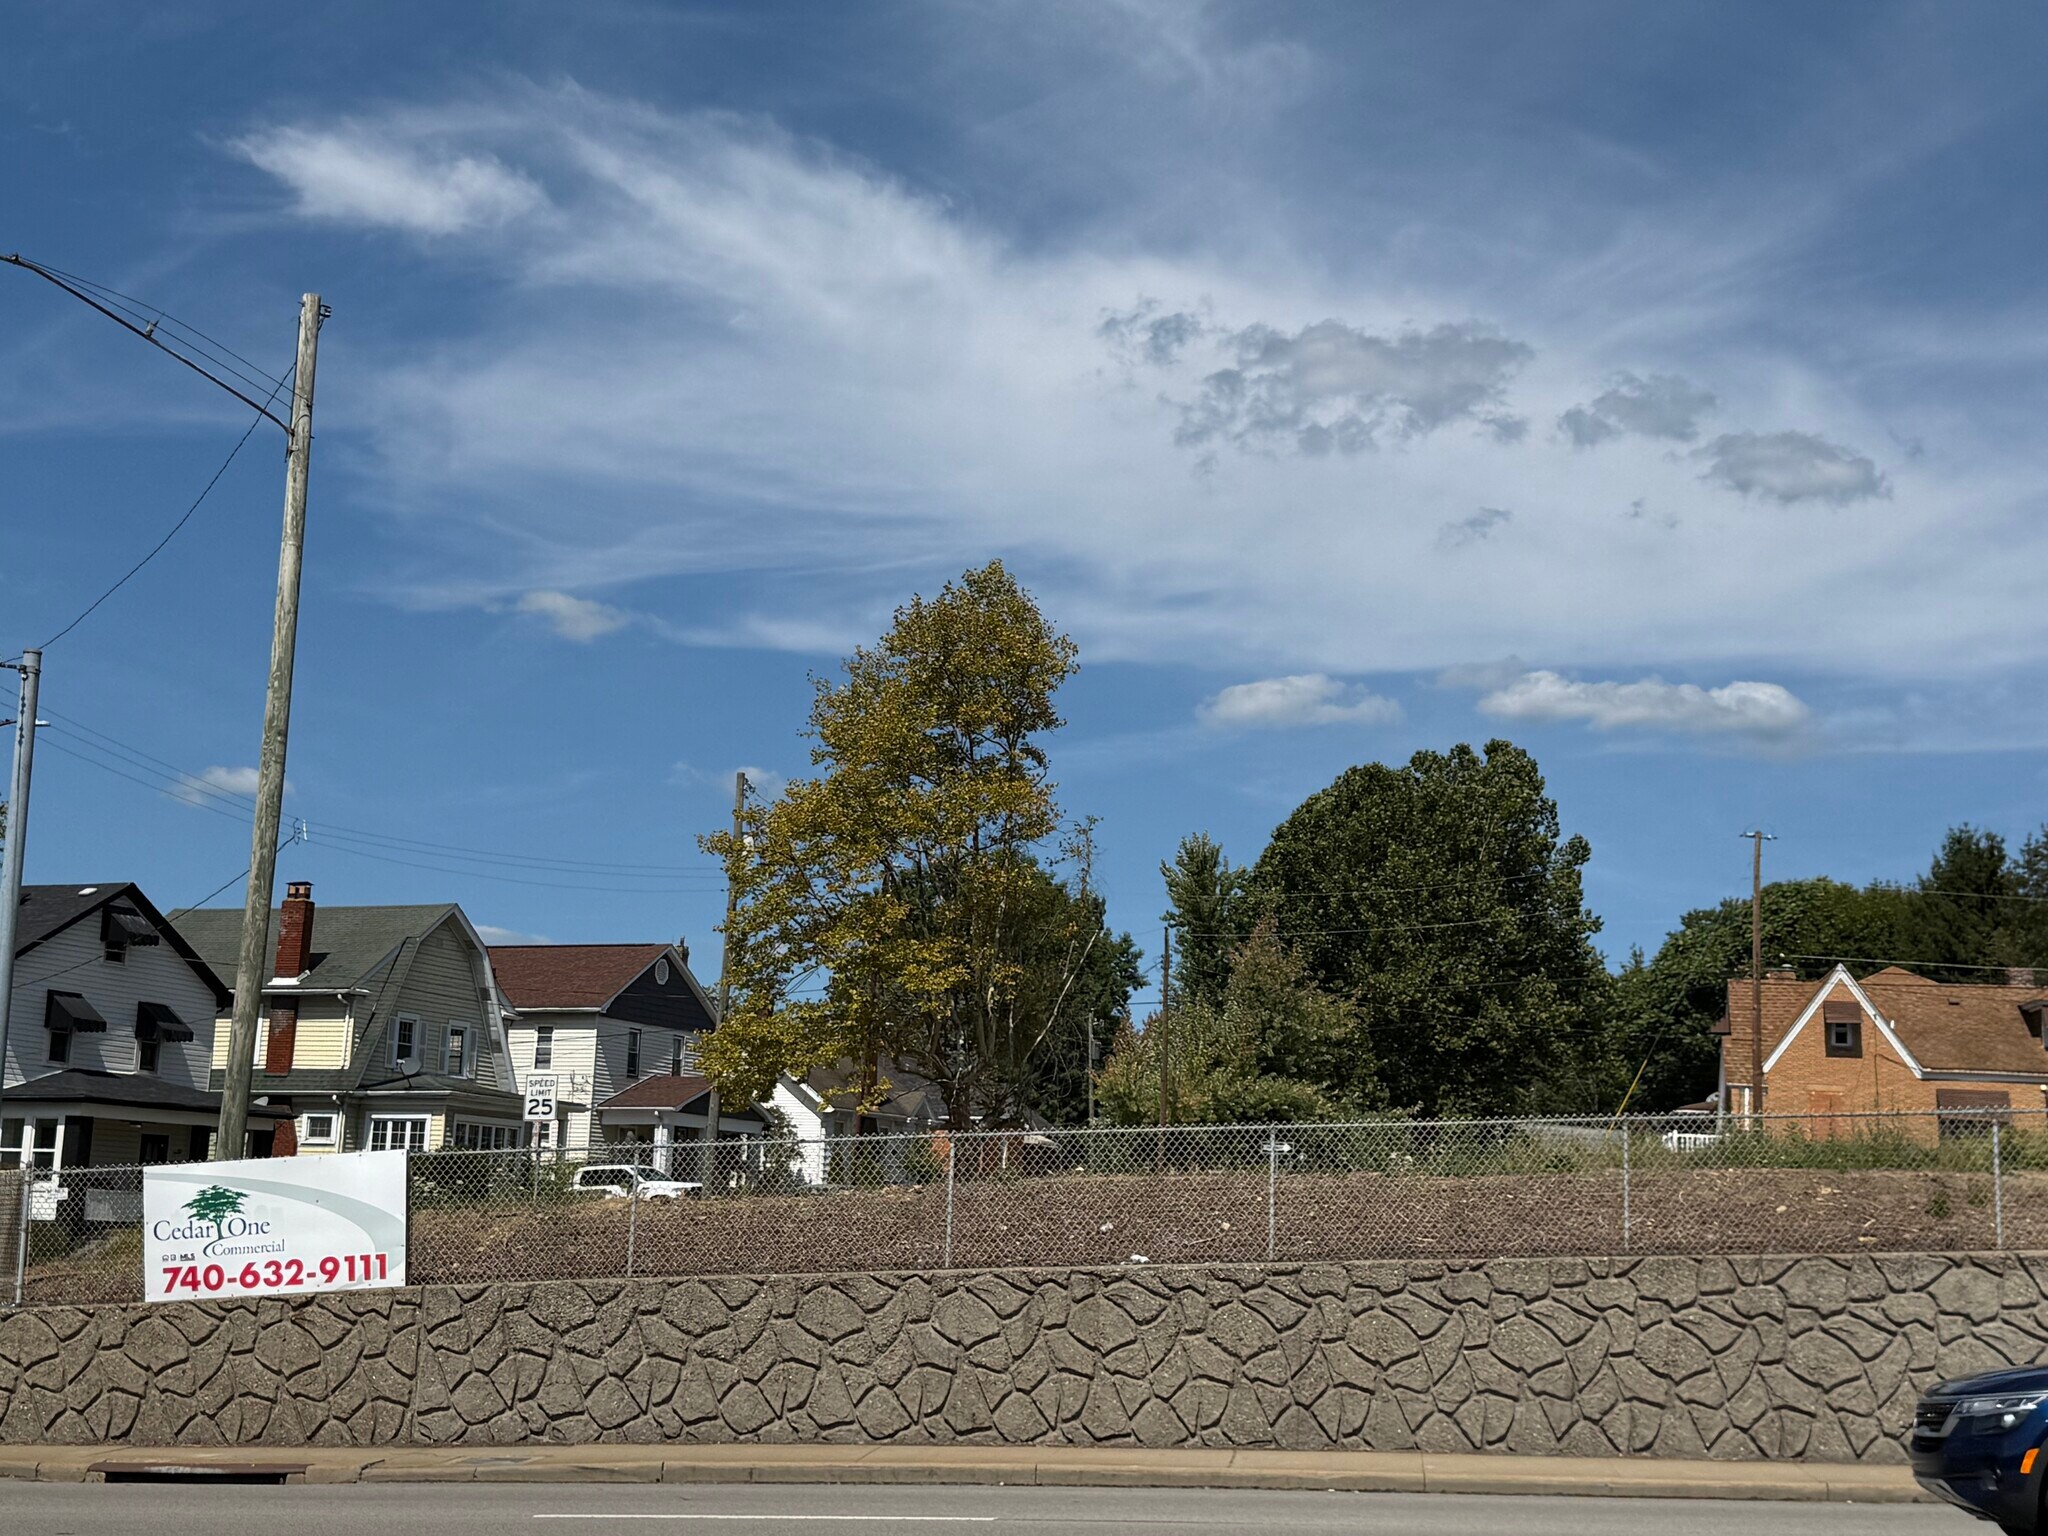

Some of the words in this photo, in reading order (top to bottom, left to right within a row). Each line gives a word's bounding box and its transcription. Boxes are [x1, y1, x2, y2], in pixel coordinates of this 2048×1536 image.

[529, 1079, 555, 1088] SPEED
[530, 1089, 552, 1097] LIMIT
[528, 1098, 553, 1116] 25
[153, 1219, 214, 1241] Cedar
[227, 1217, 271, 1237] One
[180, 1252, 195, 1261] MLS
[211, 1239, 285, 1257] Commercial
[162, 1254, 388, 1294] 740-632-9111
